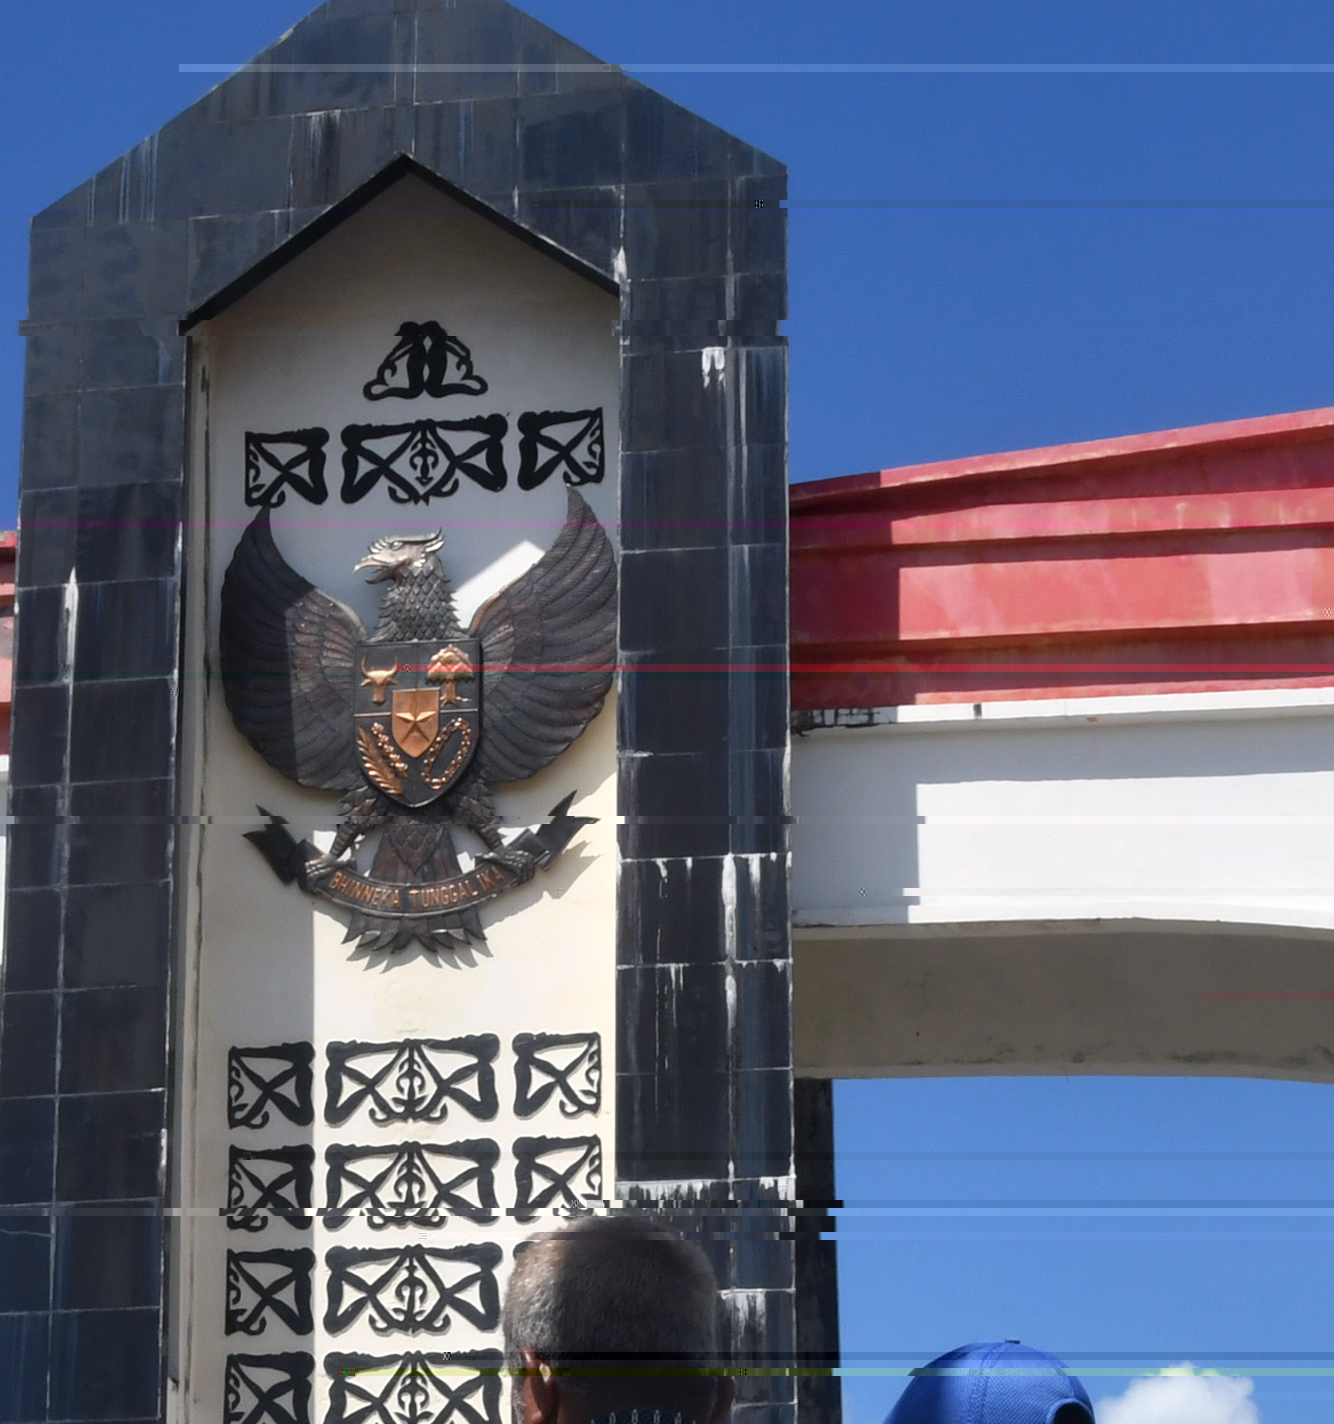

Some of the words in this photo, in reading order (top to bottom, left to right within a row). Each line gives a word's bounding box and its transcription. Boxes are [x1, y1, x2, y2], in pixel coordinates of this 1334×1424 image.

[329, 871, 402, 908] BHINNEKA
[409, 880, 479, 908] TUNGGAL
[476, 866, 506, 892] IKA
